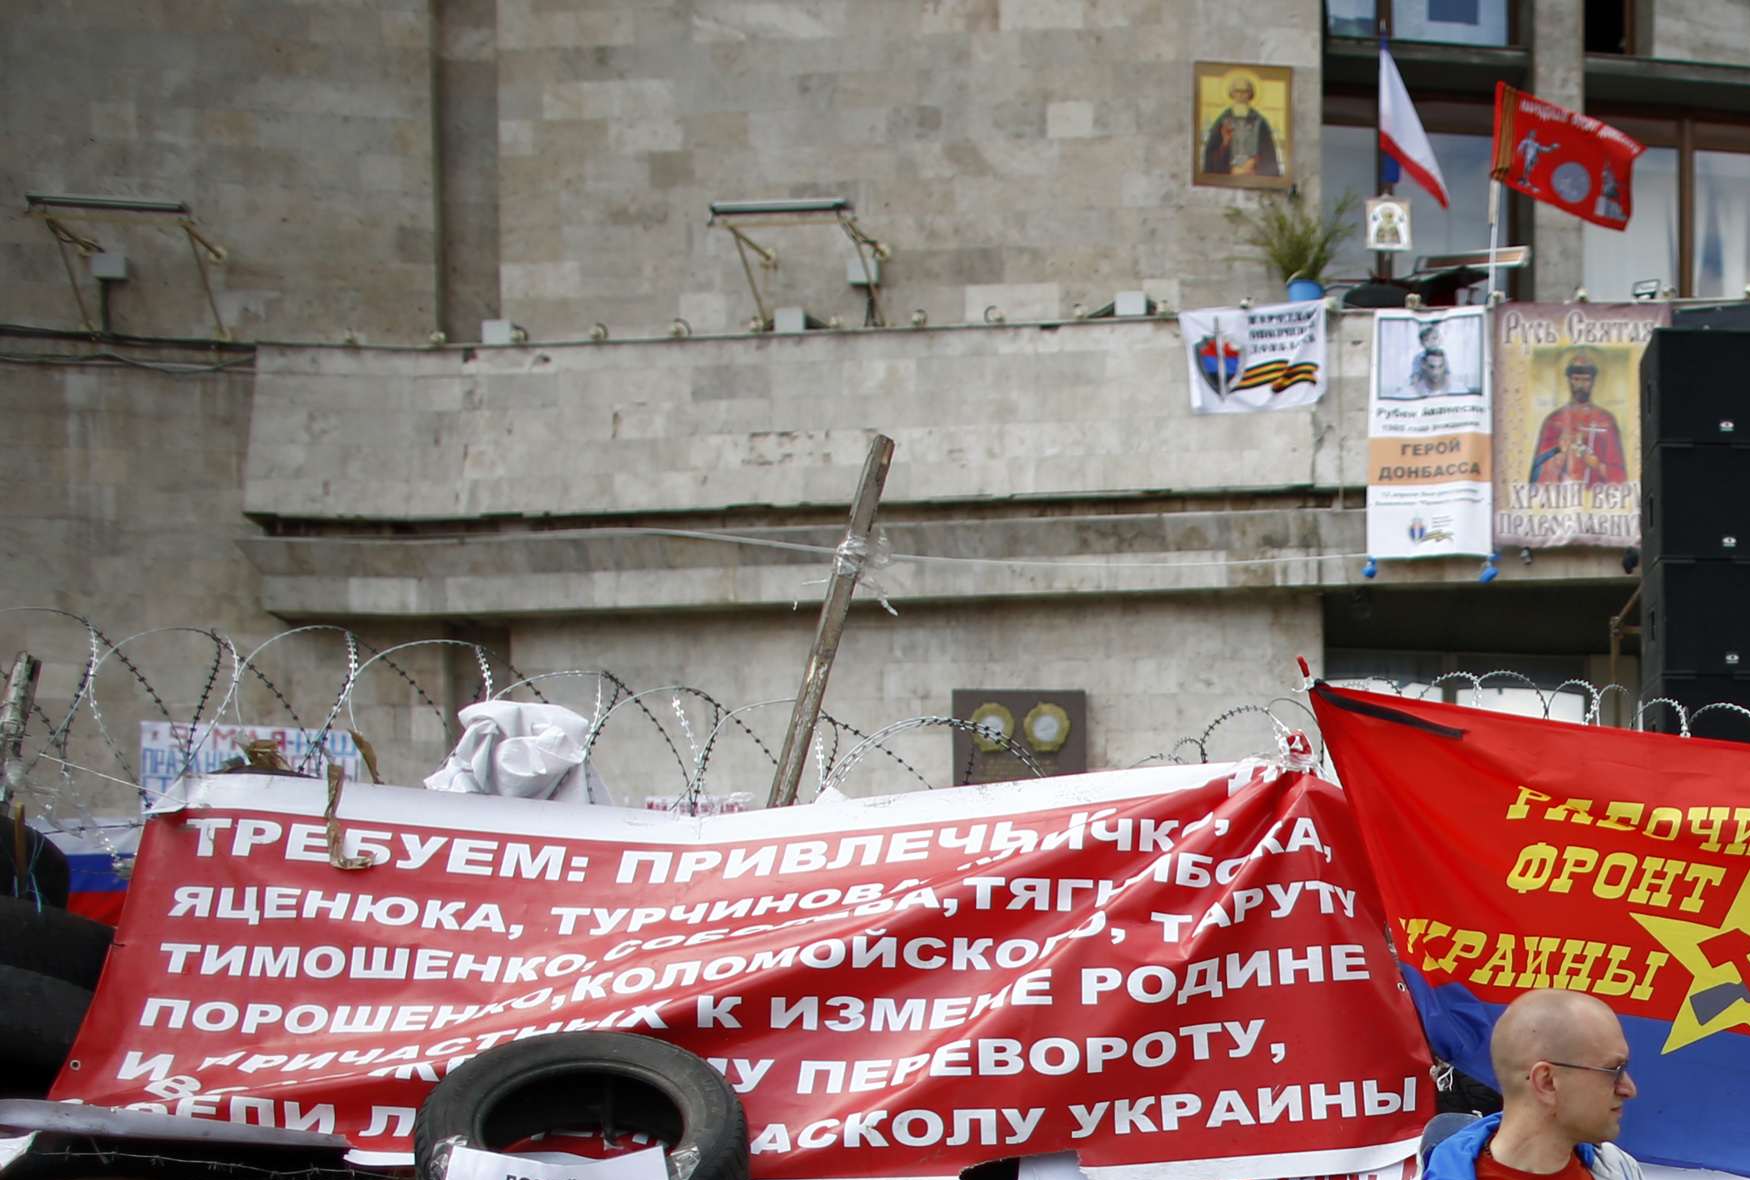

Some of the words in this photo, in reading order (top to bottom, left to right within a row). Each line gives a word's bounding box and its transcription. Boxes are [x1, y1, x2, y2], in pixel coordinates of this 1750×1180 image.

[1378, 462, 1481, 481] ДОНБАССА
[1400, 437, 1461, 457] ГЕРОЙ
[188, 818, 590, 882] ТРЕБУЕМ:
[1506, 843, 1726, 913] ФРОНТ
[168, 886, 524, 940] ЯЦЕНЮКА,
[1151, 881, 1356, 942] ТАРУТУ
[116, 1051, 176, 1080] И
[697, 996, 742, 1029] К
[1080, 944, 1371, 1006] РОДИНЕ
[797, 1019, 1285, 1094] ПЕРЕВОРОТУ,
[751, 1104, 1056, 1153] АСКОЛУ
[1069, 1076, 1418, 1139] УКРАИНЫ
